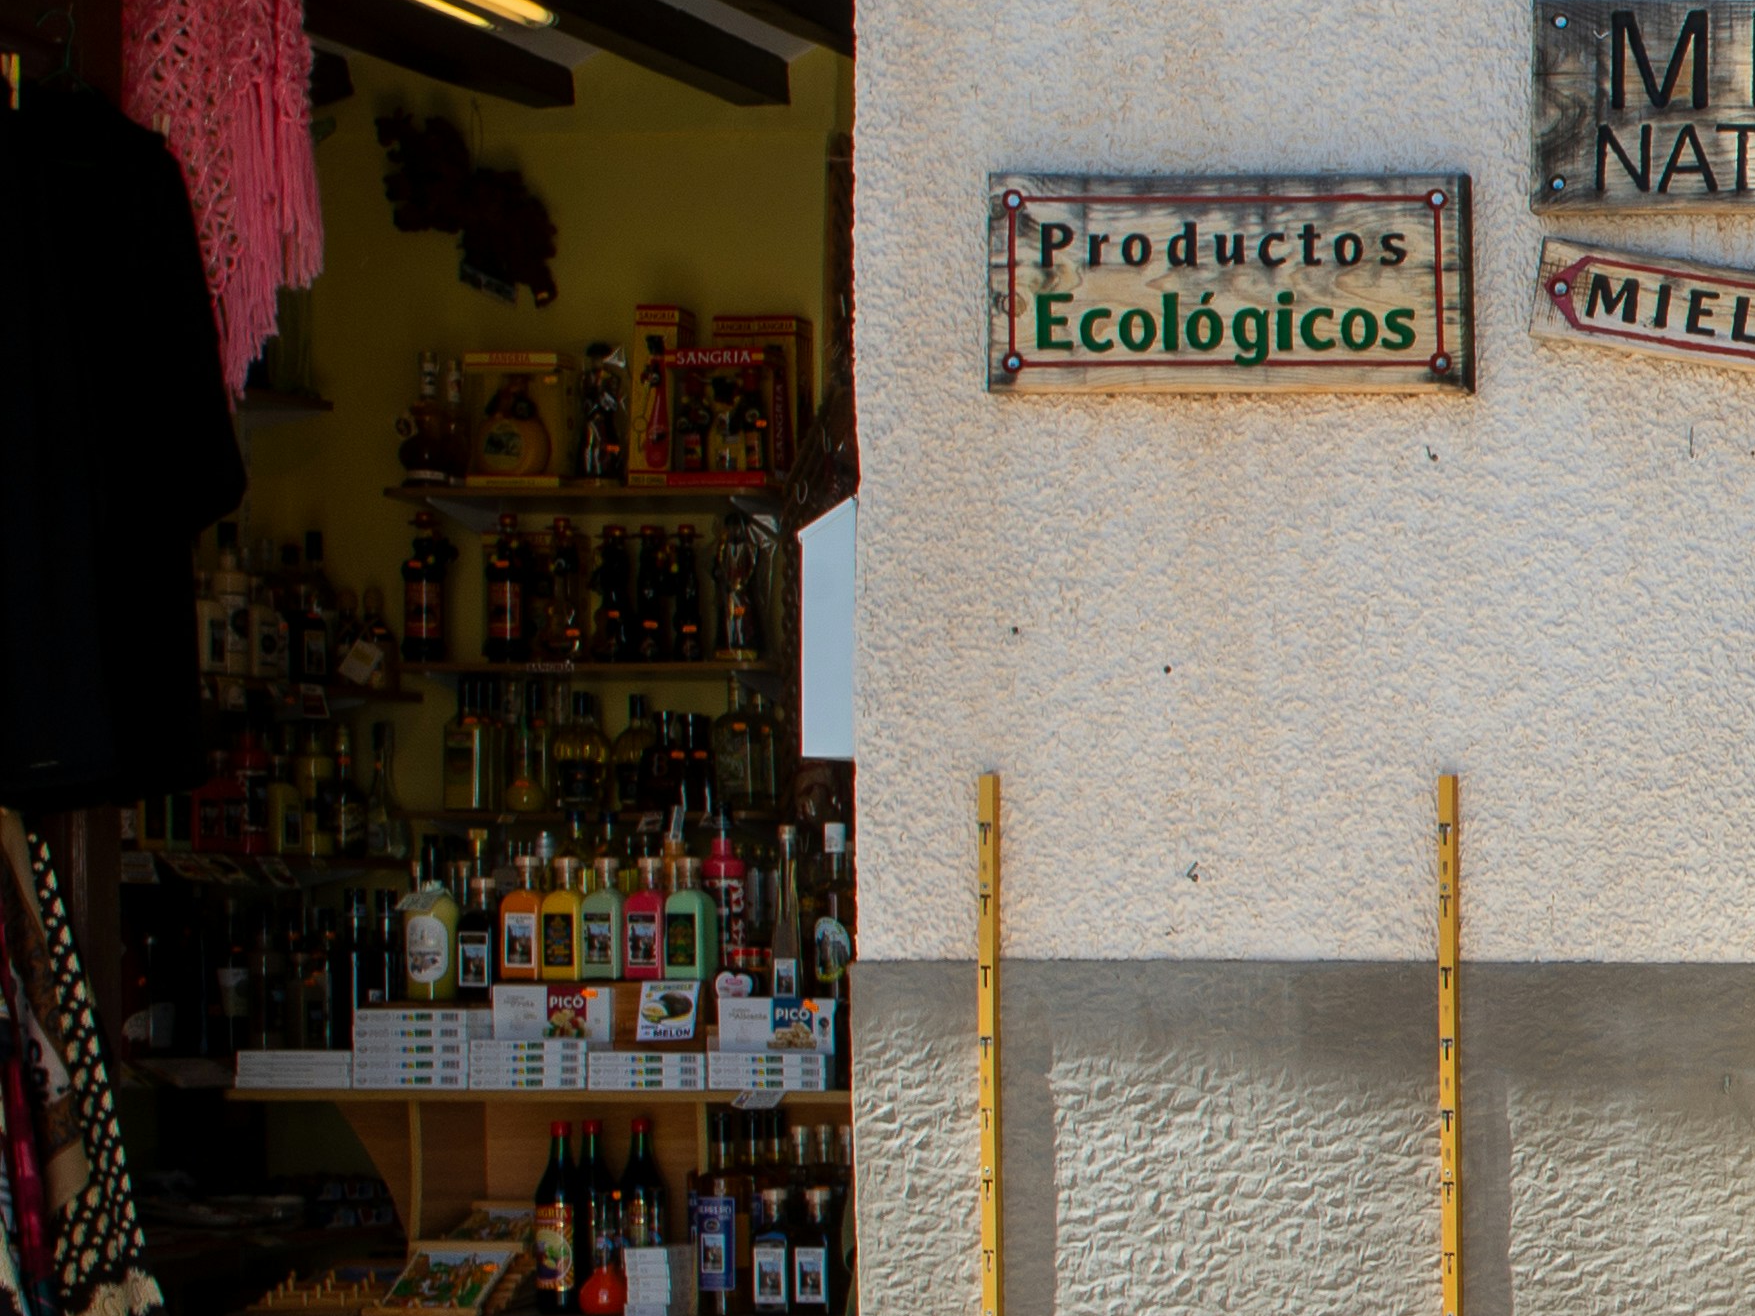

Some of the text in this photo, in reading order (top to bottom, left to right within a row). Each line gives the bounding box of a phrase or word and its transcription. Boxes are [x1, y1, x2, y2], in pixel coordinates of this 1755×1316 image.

[1039, 221, 1408, 269] Productos
[1035, 290, 1417, 366] Ecológicos
[676, 351, 751, 365] SANGRIA
[548, 994, 585, 1010] PICÓ
[652, 1028, 692, 1038] MELON
